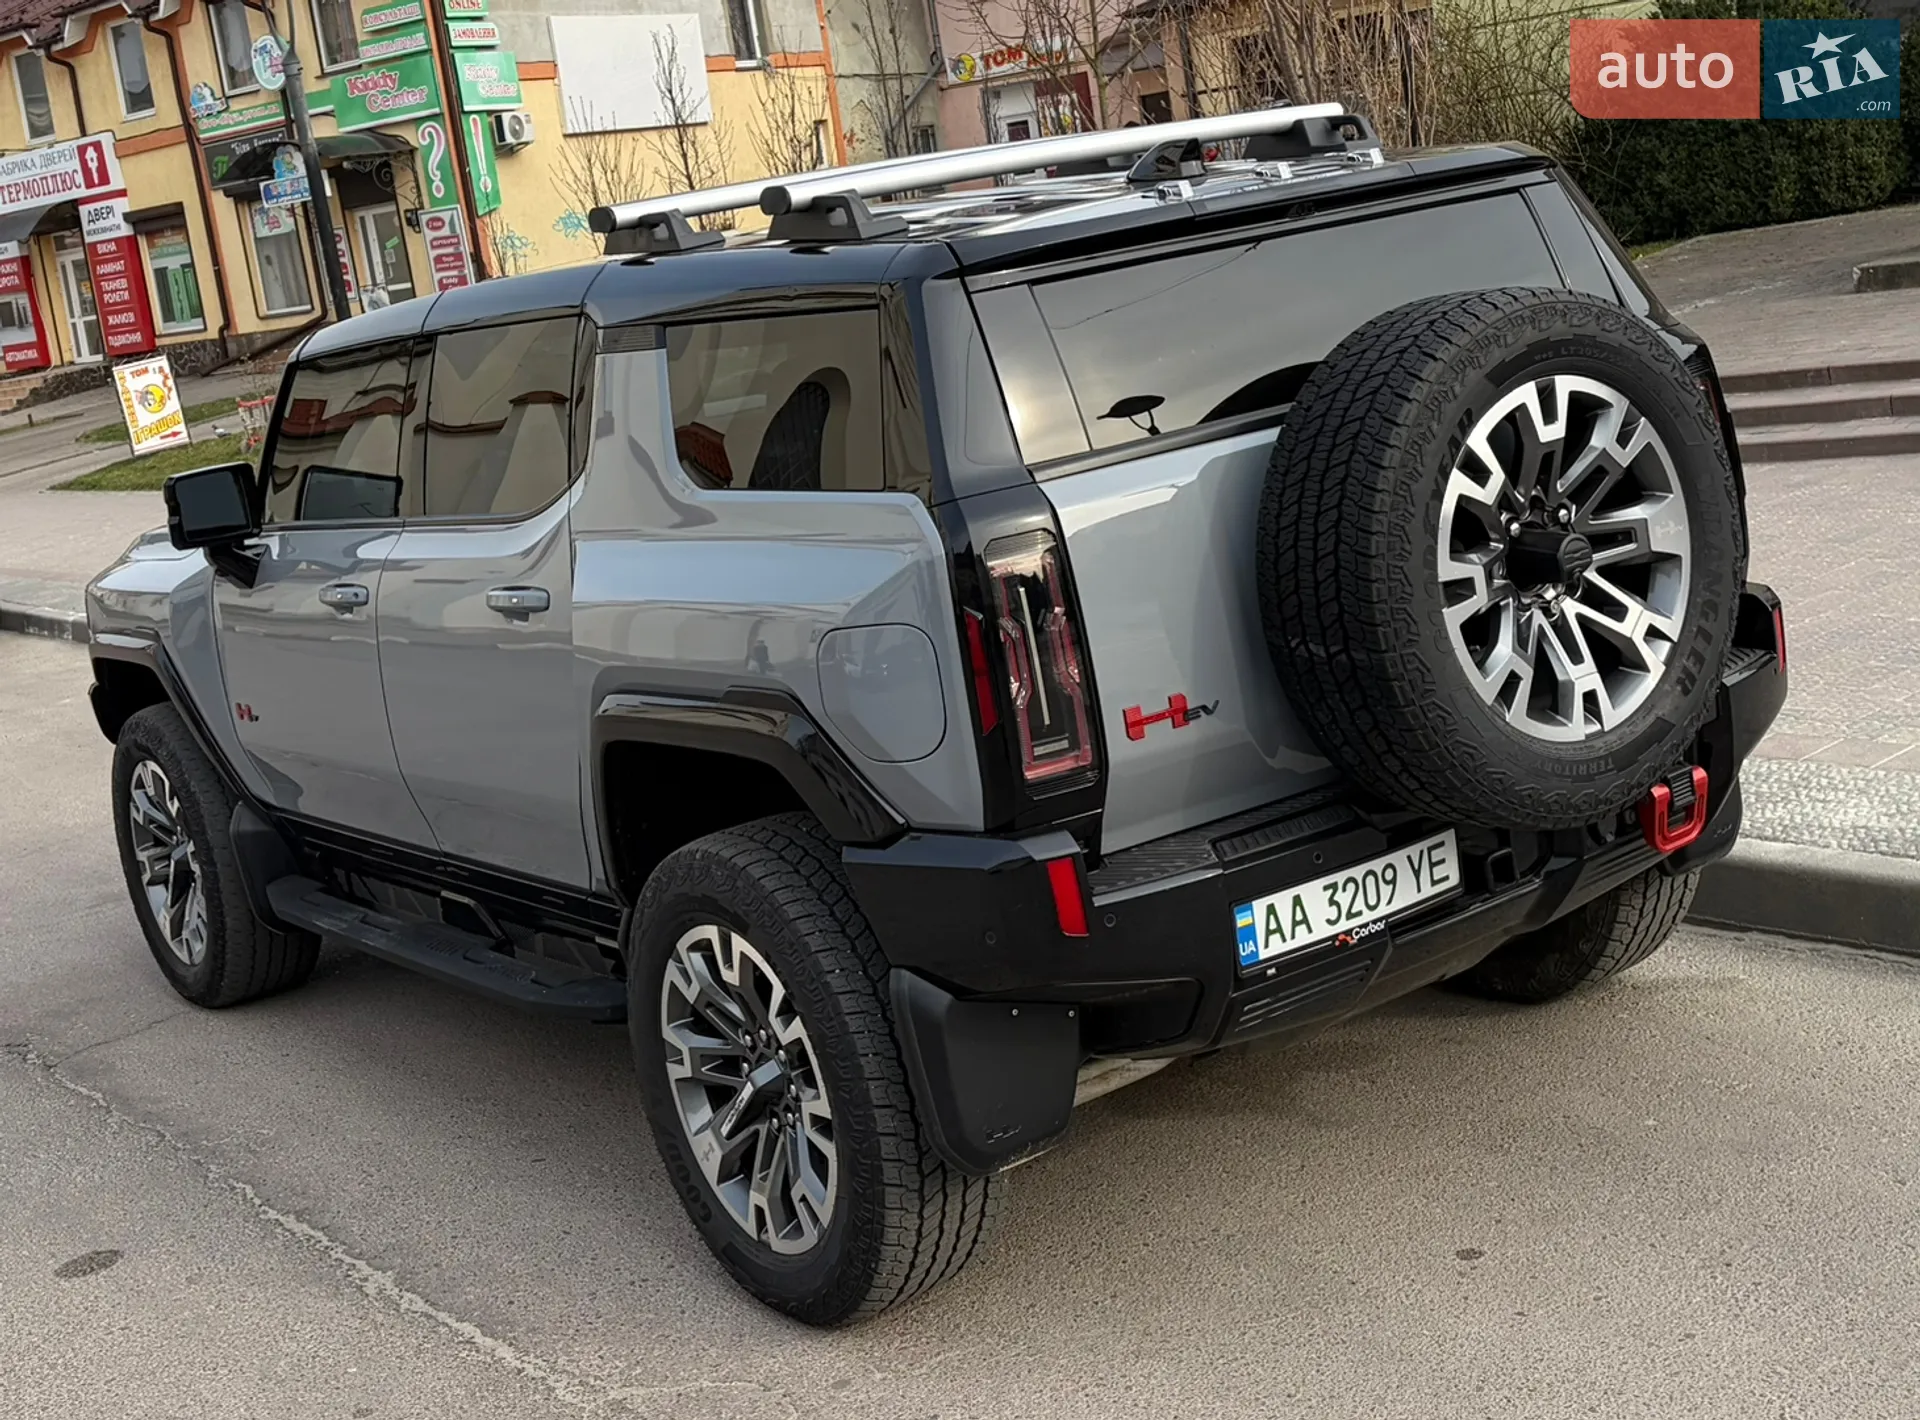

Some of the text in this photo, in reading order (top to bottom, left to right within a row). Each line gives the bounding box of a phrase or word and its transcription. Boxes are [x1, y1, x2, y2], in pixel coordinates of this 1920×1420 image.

[346, 69, 398, 97] Kiddy
[464, 64, 499, 82] Kiddy
[366, 85, 428, 113] Center
[39, 144, 77, 170] ДВЕРЕЙ
[0, 168, 82, 205] ТЕРМОПЛЮС
[87, 205, 116, 226] ДВЕРІ
[96, 241, 117, 255] ВІКНА
[96, 260, 125, 275] ЛАМІНАТ
[100, 278, 128, 292] ТКАНЕВІ
[103, 289, 130, 304] РОЛЕТИ
[107, 311, 136, 326] ЖАЛЮЗІ
[132, 409, 182, 445] ІГРАШОК
[1533, 756, 1615, 776] TERRITORY
[1263, 840, 1451, 950] AA 3209 YE
[1238, 943, 1257, 957] UA
